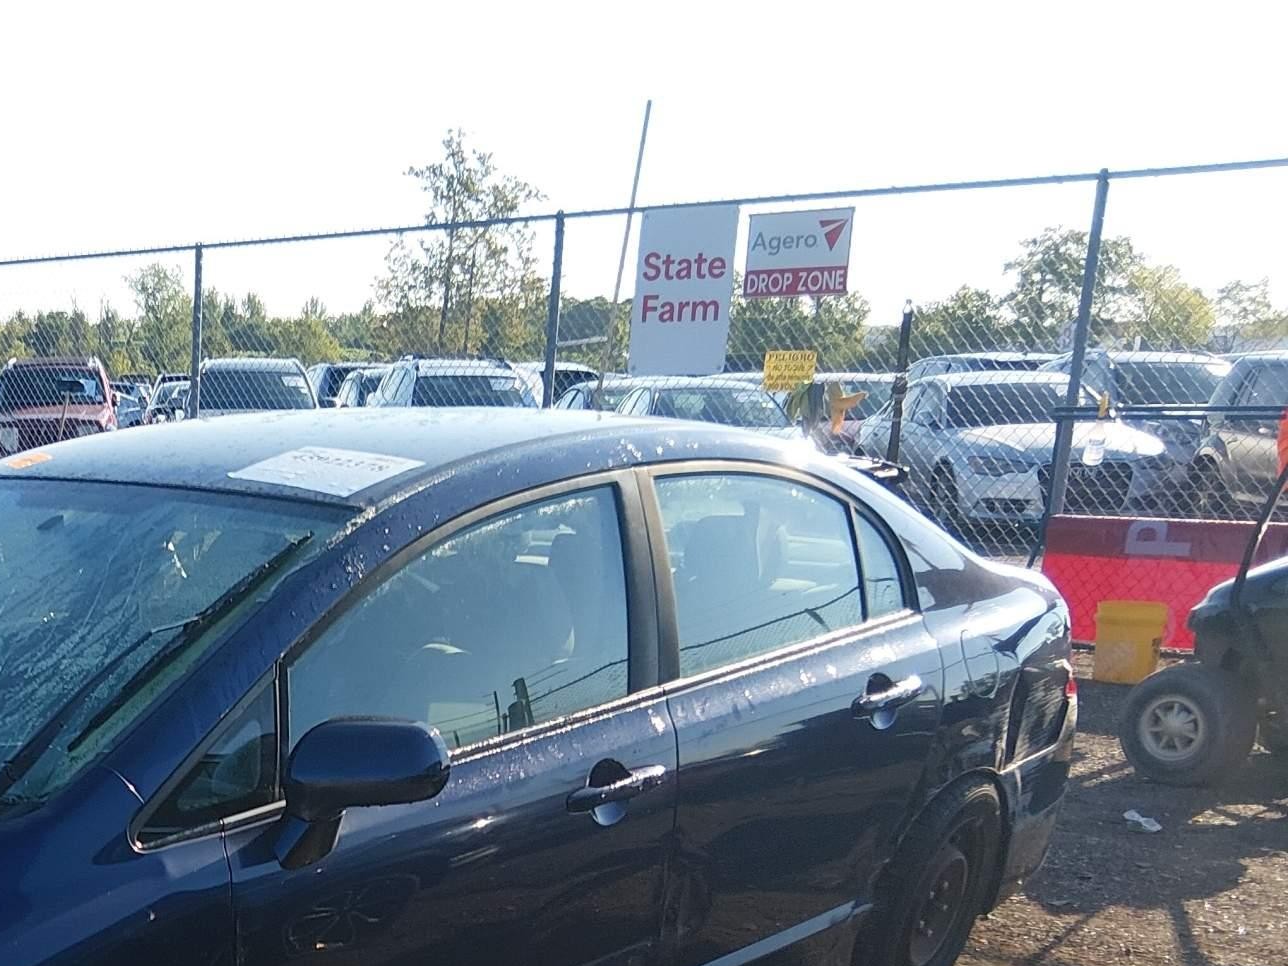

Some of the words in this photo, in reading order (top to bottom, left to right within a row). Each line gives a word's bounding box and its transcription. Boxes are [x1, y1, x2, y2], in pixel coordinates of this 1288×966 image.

[751, 231, 817, 256] Agero
[642, 252, 727, 281] State
[746, 272, 793, 294] DROP
[796, 269, 845, 292] ZONE
[641, 294, 720, 323] Farm
